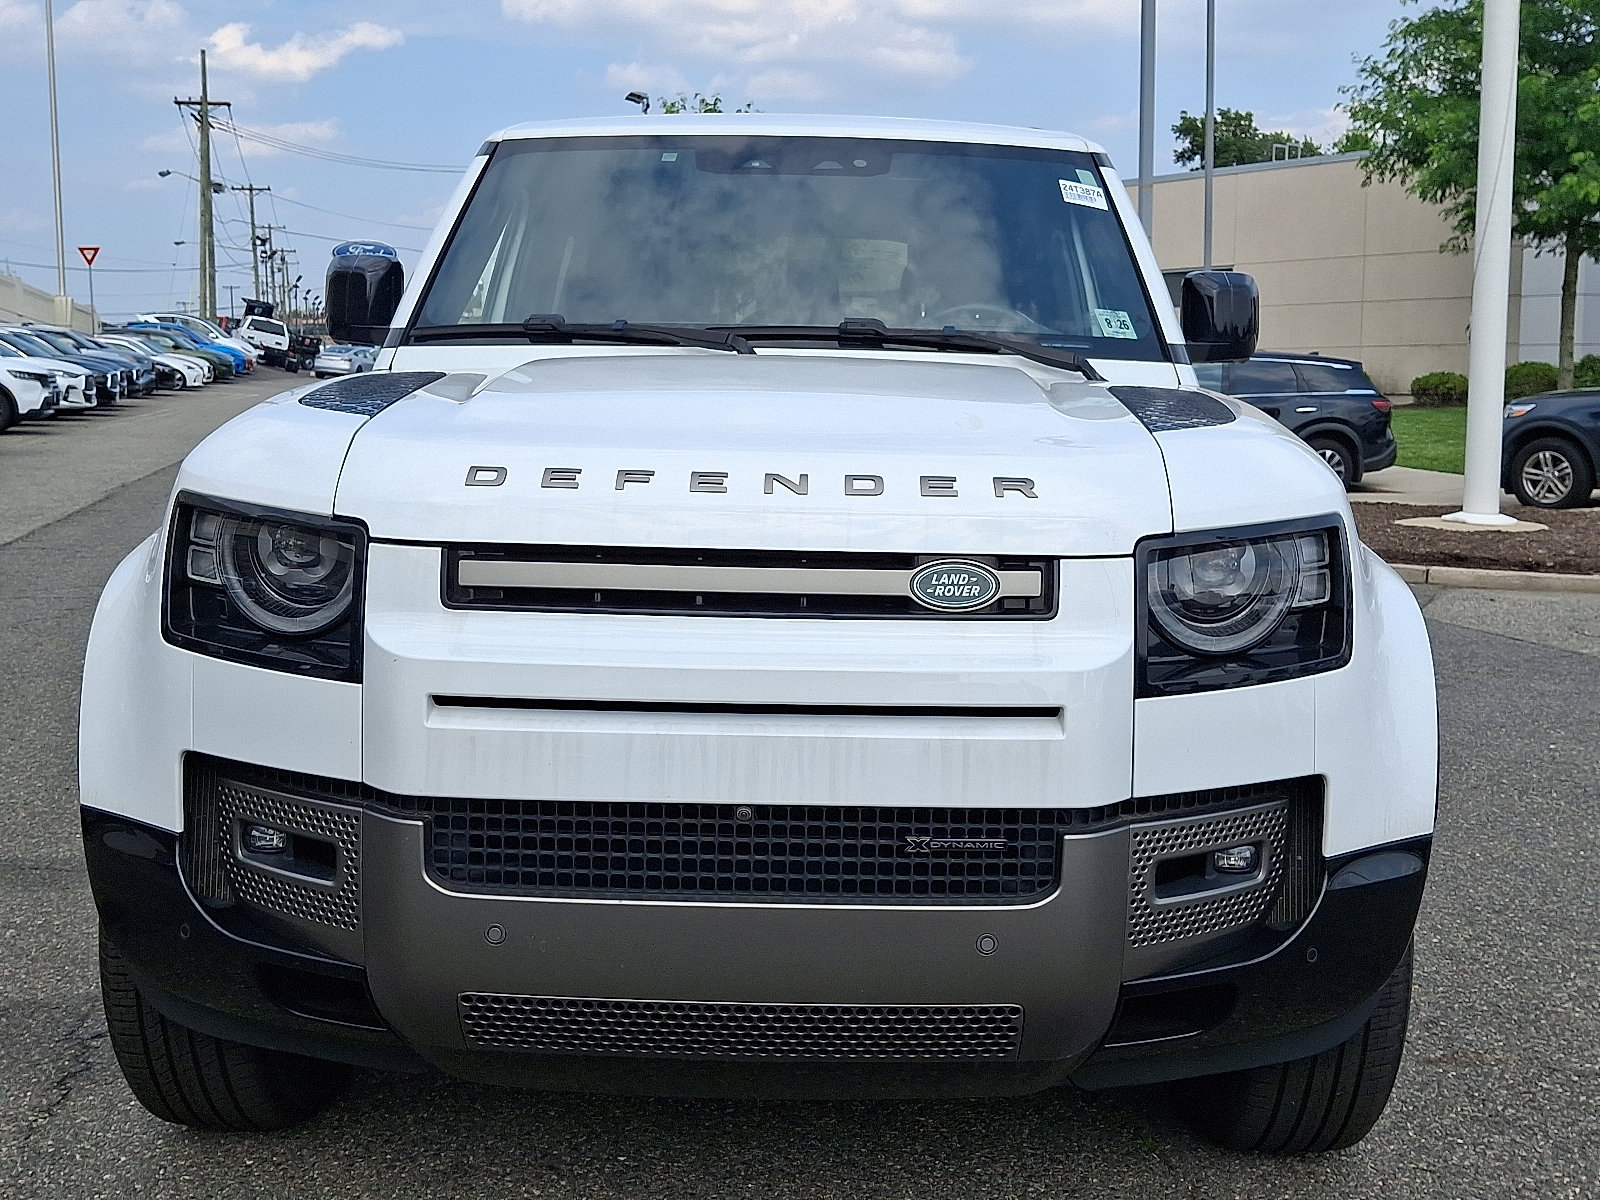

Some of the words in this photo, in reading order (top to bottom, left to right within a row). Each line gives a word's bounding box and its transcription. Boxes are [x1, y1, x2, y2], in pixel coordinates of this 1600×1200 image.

[1062, 184, 1102, 198] 24T387A
[1105, 318, 1112, 328] 8
[465, 465, 1039, 498] DEFENDER
[931, 573, 969, 585] LAND
[934, 585, 980, 597] ROVER
